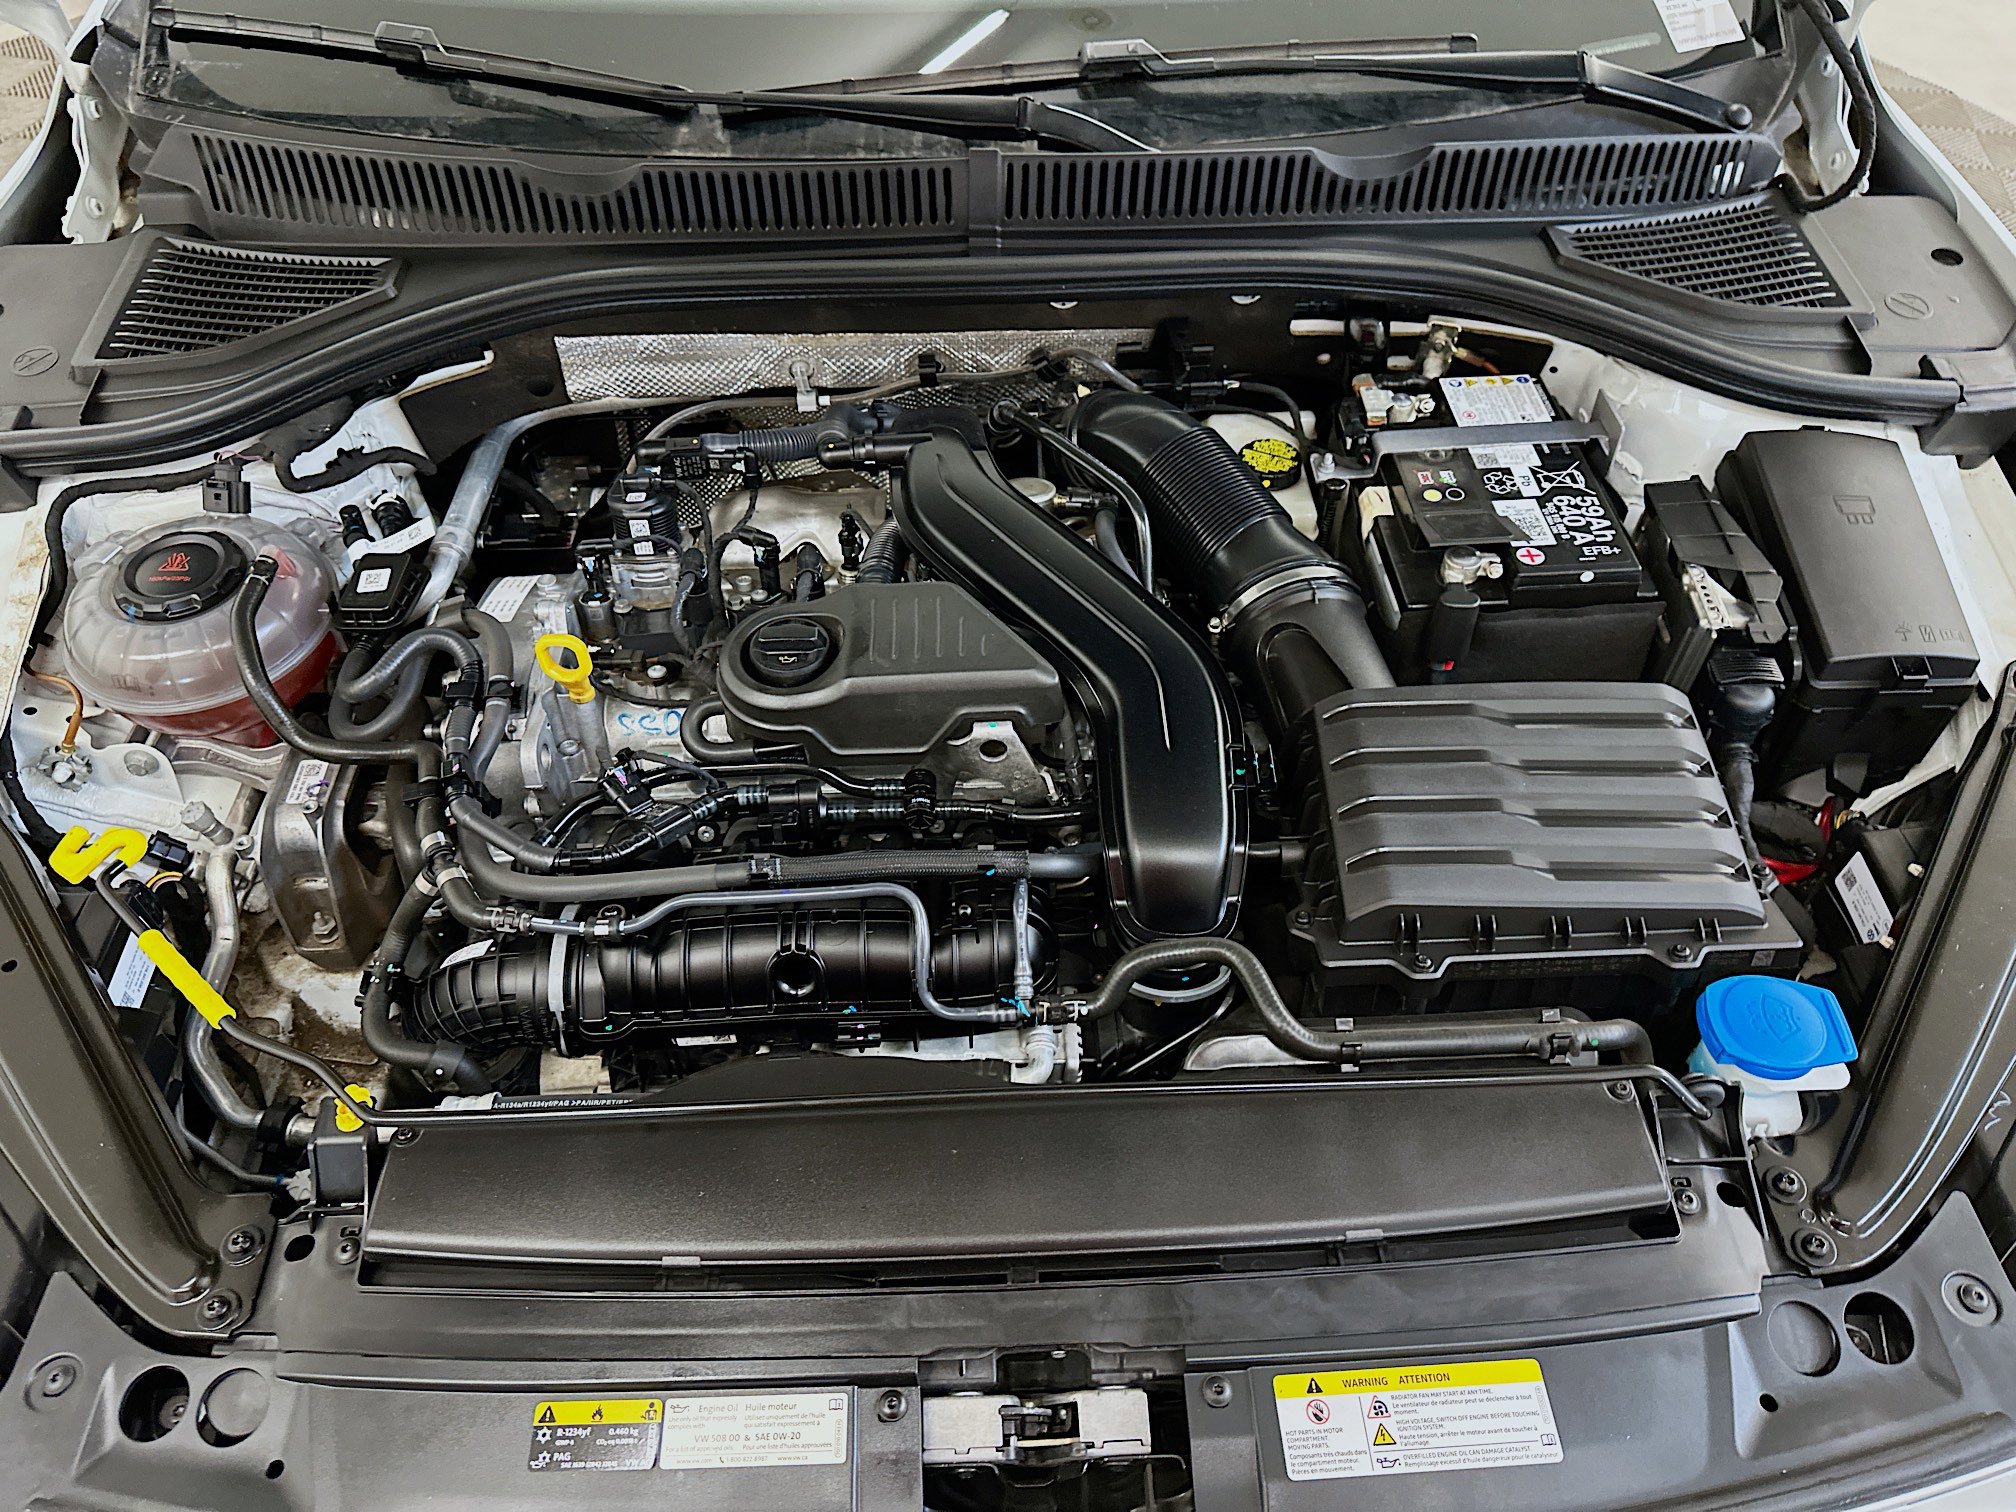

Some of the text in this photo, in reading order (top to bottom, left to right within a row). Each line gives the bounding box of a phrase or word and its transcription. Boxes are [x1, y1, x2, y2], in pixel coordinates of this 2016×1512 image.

[1519, 475, 1531, 487] Pb
[1552, 495, 1587, 527] 640
[1575, 495, 1618, 542] 59Ah
[1568, 530, 1596, 546] A
[1582, 545, 1622, 556] EFB+
[1342, 1372, 1450, 1388] WARNING ATTENTION
[699, 1402, 797, 1415] Engine Oil Huile moteur
[694, 1435, 710, 1443] VW
[711, 1434, 727, 1443] 508
[744, 1434, 751, 1442] &
[755, 1432, 771, 1440] SAE
[553, 1452, 571, 1461] PAG
